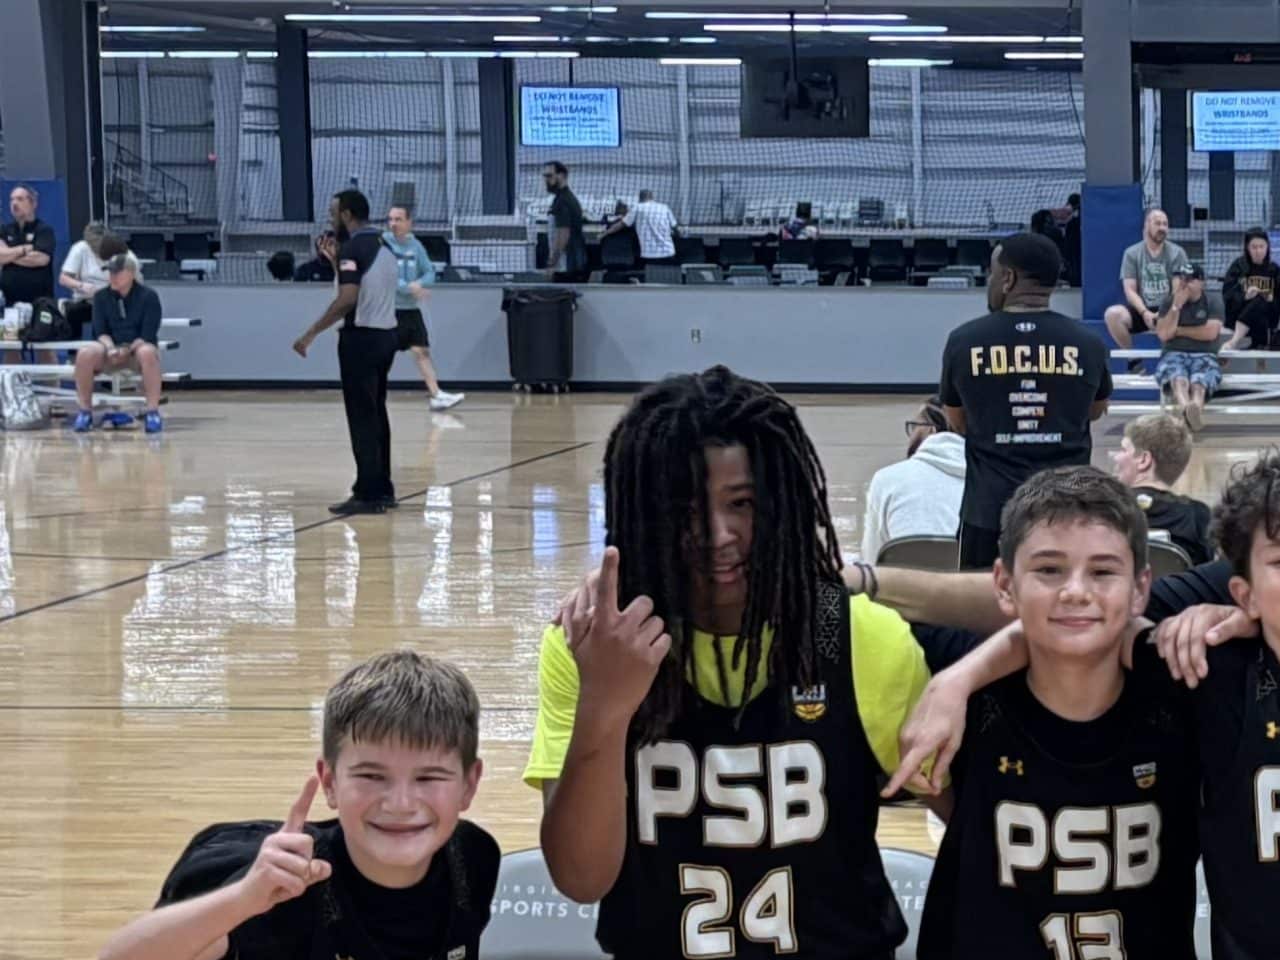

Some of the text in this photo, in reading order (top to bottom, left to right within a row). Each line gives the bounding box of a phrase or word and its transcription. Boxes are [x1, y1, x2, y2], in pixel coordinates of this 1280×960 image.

[970, 344, 1084, 377] F.O.C.U.S.
[1011, 406, 1045, 417] COMPETE
[1017, 420, 1039, 430] UNITY
[635, 739, 828, 848] PSB
[995, 800, 1161, 894] PSB
[679, 863, 798, 960] 24
